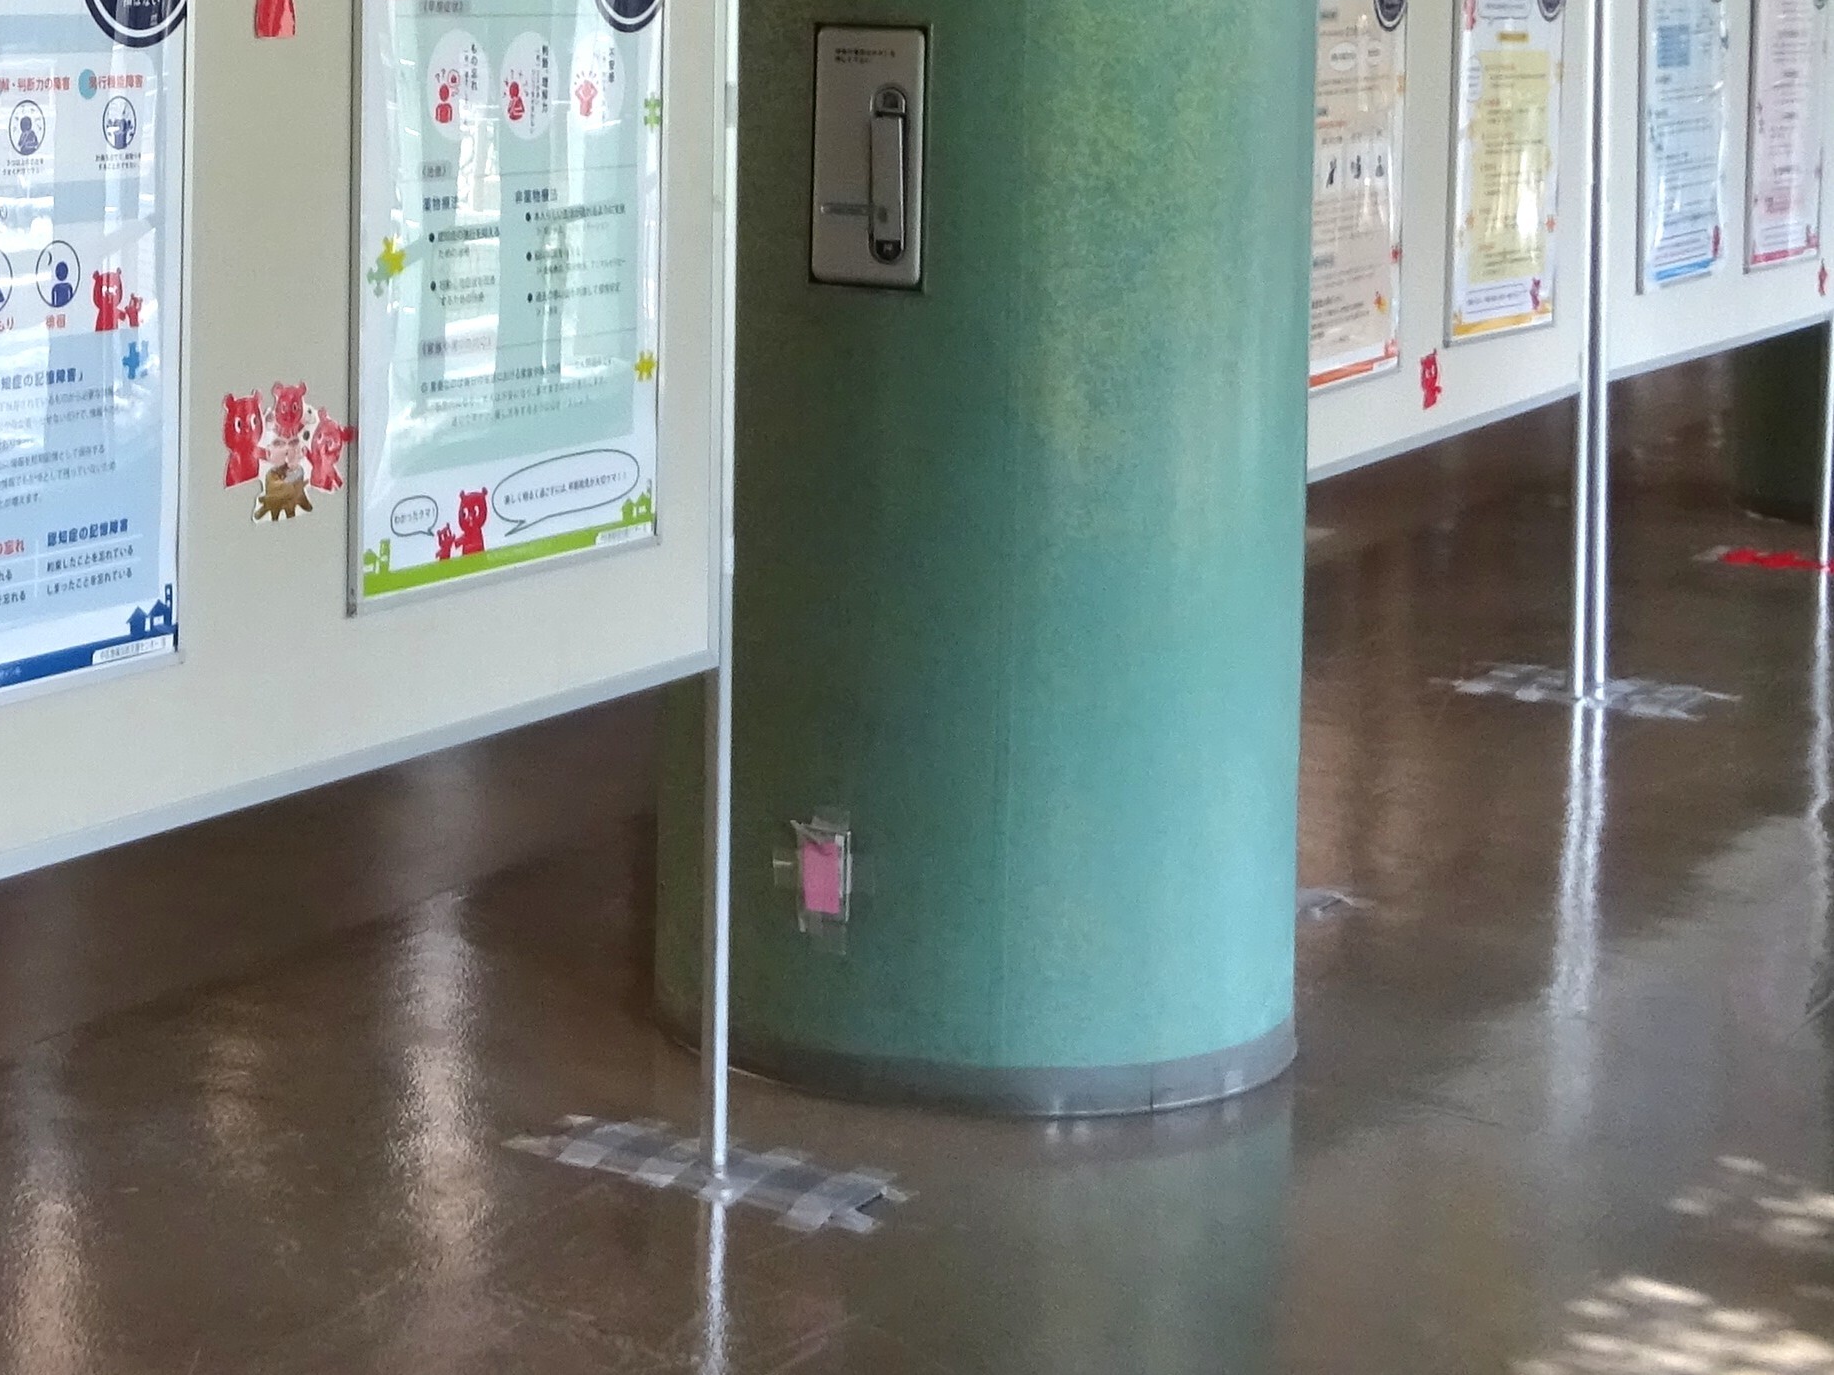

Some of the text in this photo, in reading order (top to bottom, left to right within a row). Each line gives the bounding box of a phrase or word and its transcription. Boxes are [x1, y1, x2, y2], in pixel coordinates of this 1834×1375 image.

[47, 518, 129, 548] 認知症の記憶障害
[46, 567, 133, 596] しまったことを忘れている
